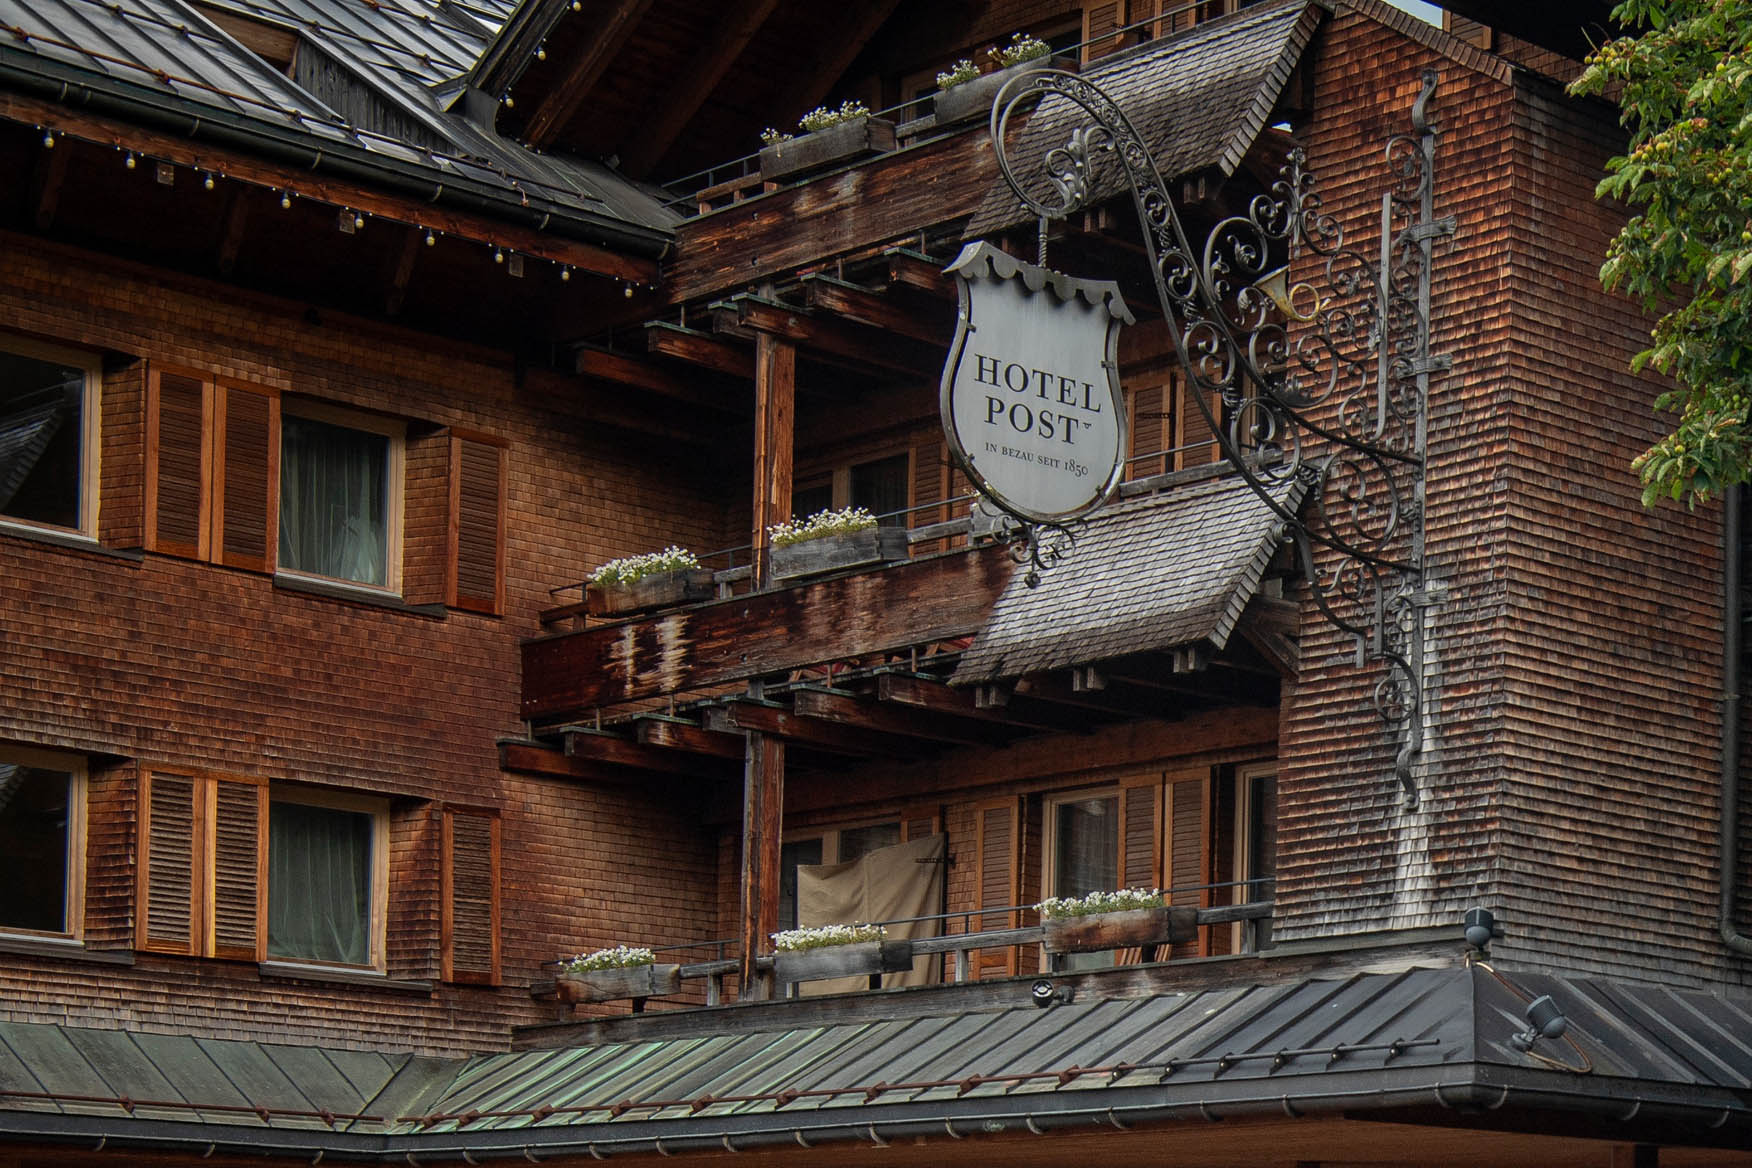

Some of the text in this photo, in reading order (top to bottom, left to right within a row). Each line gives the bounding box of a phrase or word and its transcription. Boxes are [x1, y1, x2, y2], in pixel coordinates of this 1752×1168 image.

[974, 353, 1101, 413] HOTEL
[984, 395, 1079, 445] POST
[985, 442, 1089, 477] IN BEZAU SEIT 1850
